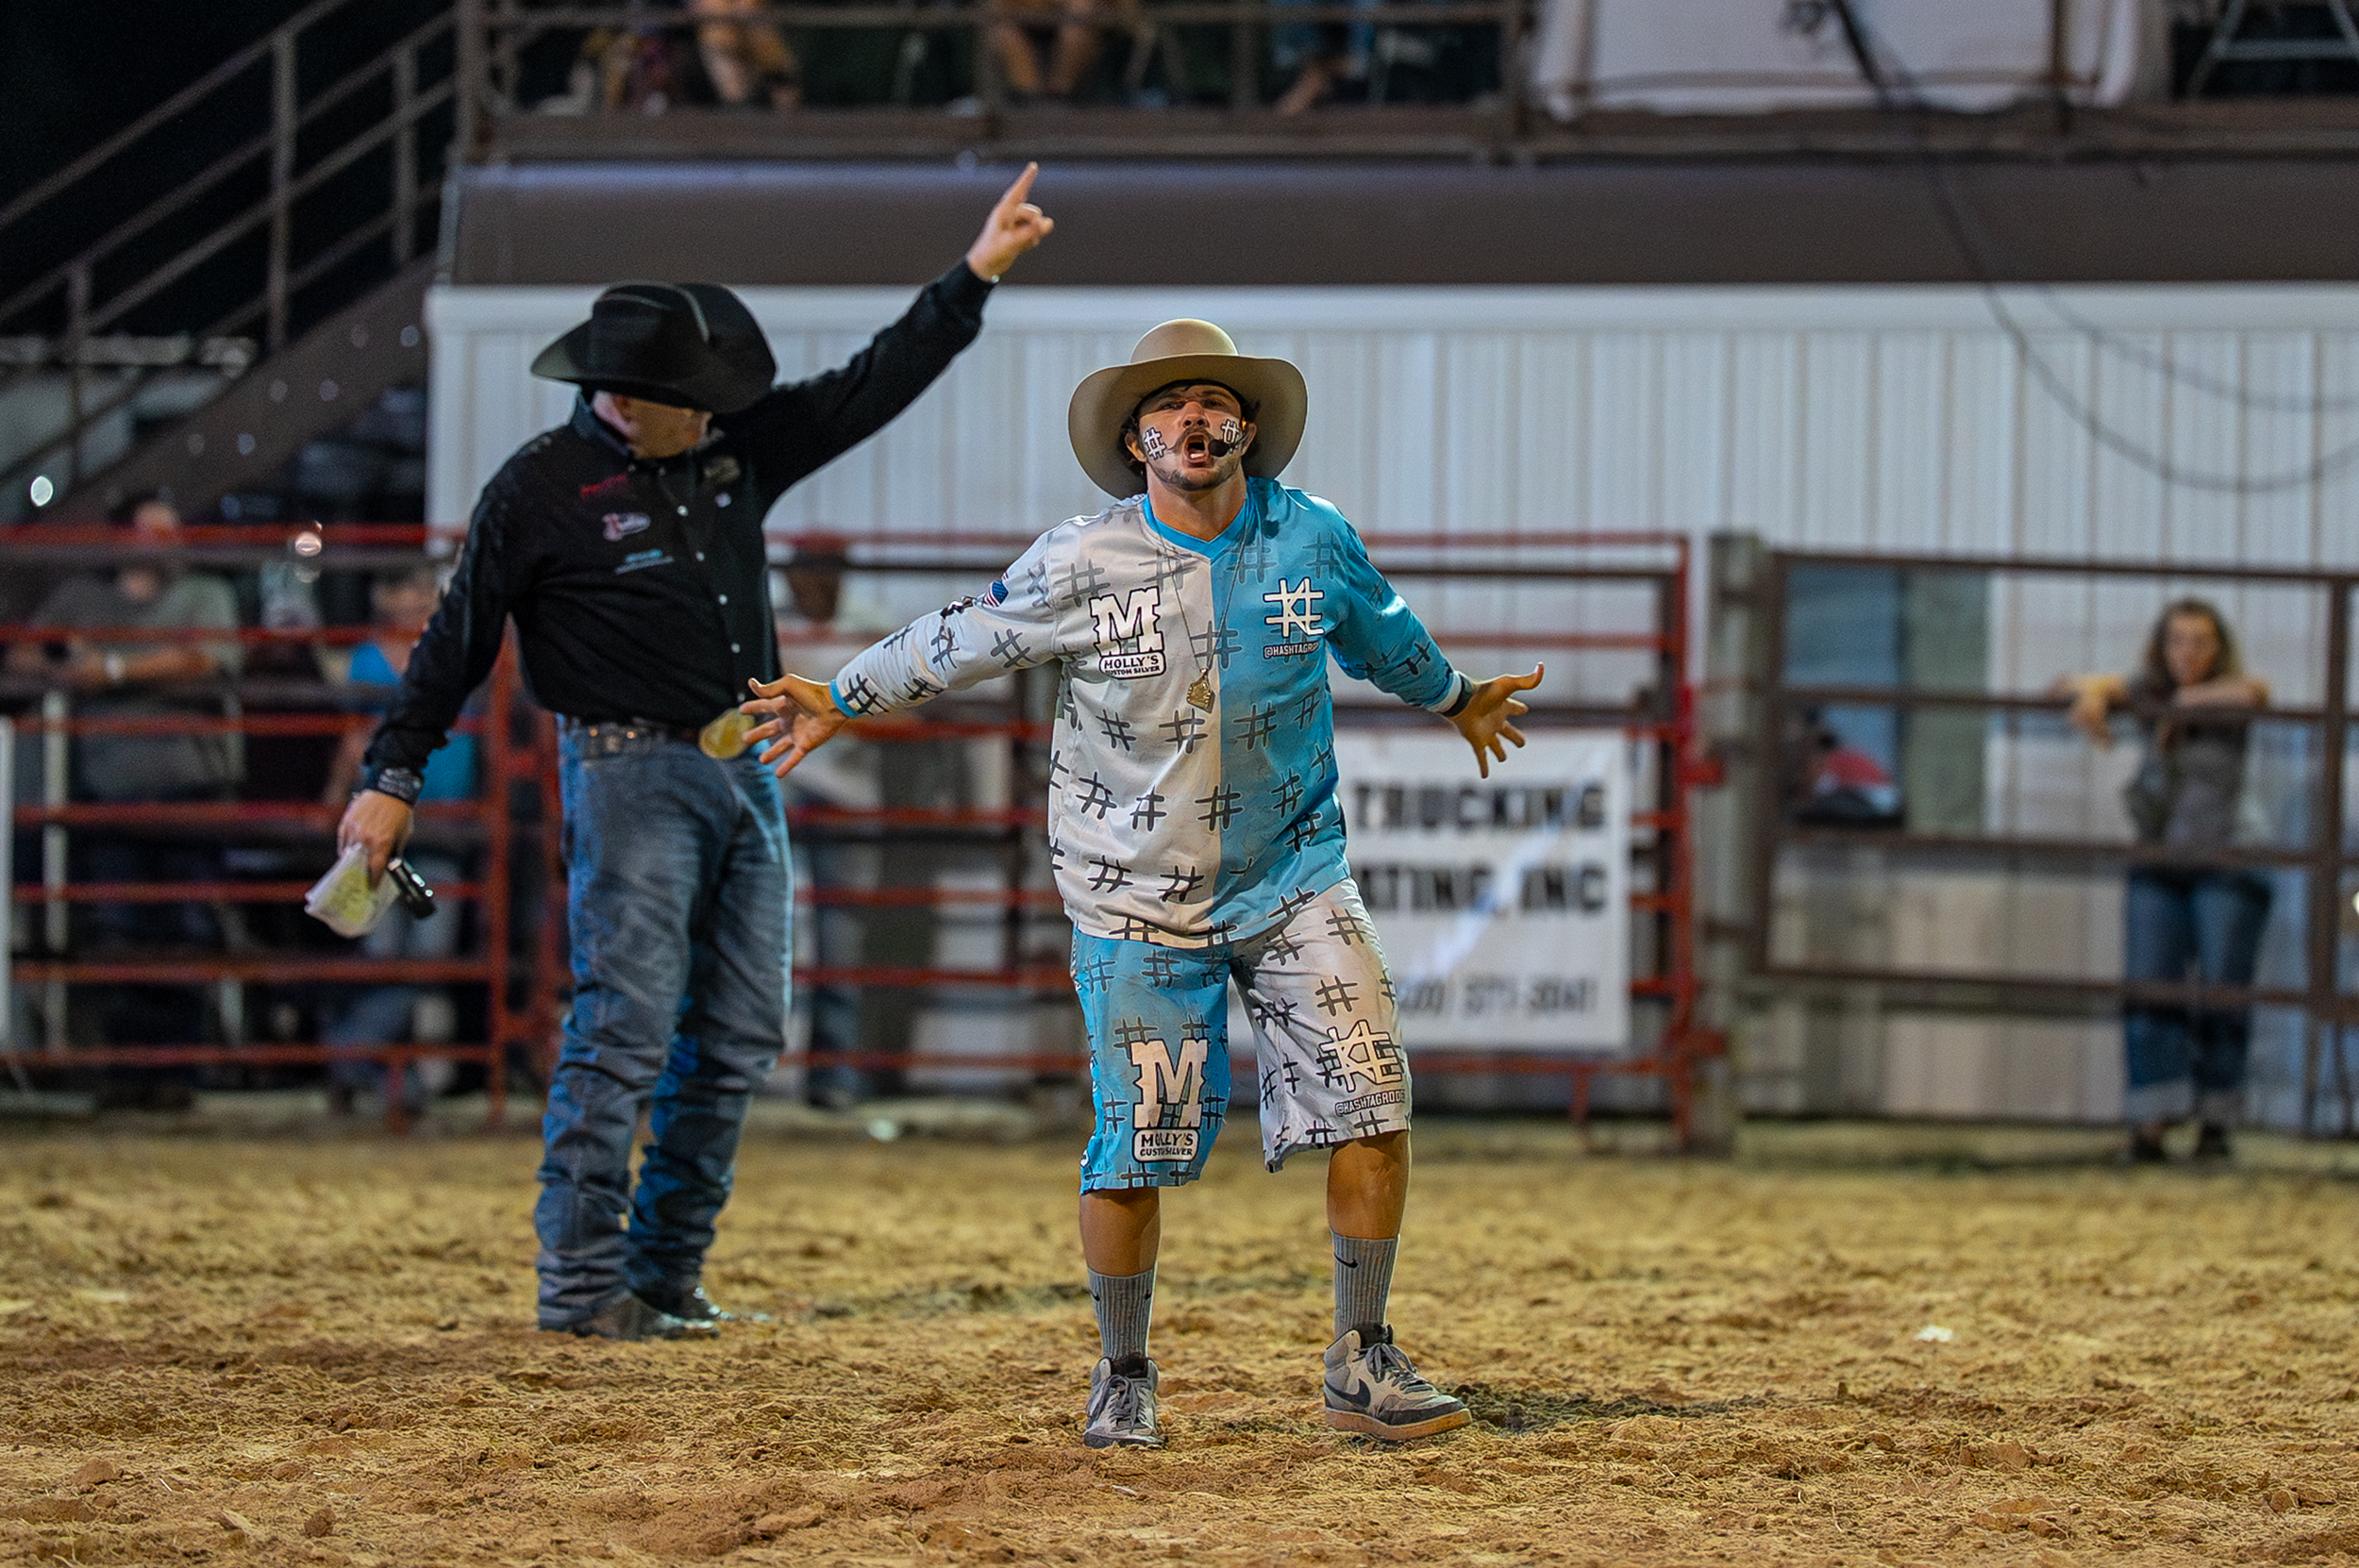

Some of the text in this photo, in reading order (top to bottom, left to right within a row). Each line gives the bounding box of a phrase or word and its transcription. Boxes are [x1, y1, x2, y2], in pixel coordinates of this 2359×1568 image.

[1089, 585, 1164, 657] M
[1104, 655, 1160, 669] MOLLY'S
[1133, 665, 1161, 674] SILVER
[1355, 784, 1604, 830] TRUCKING
[1131, 1038, 1209, 1129] M
[1141, 1132, 1194, 1147] MOLLY'S
